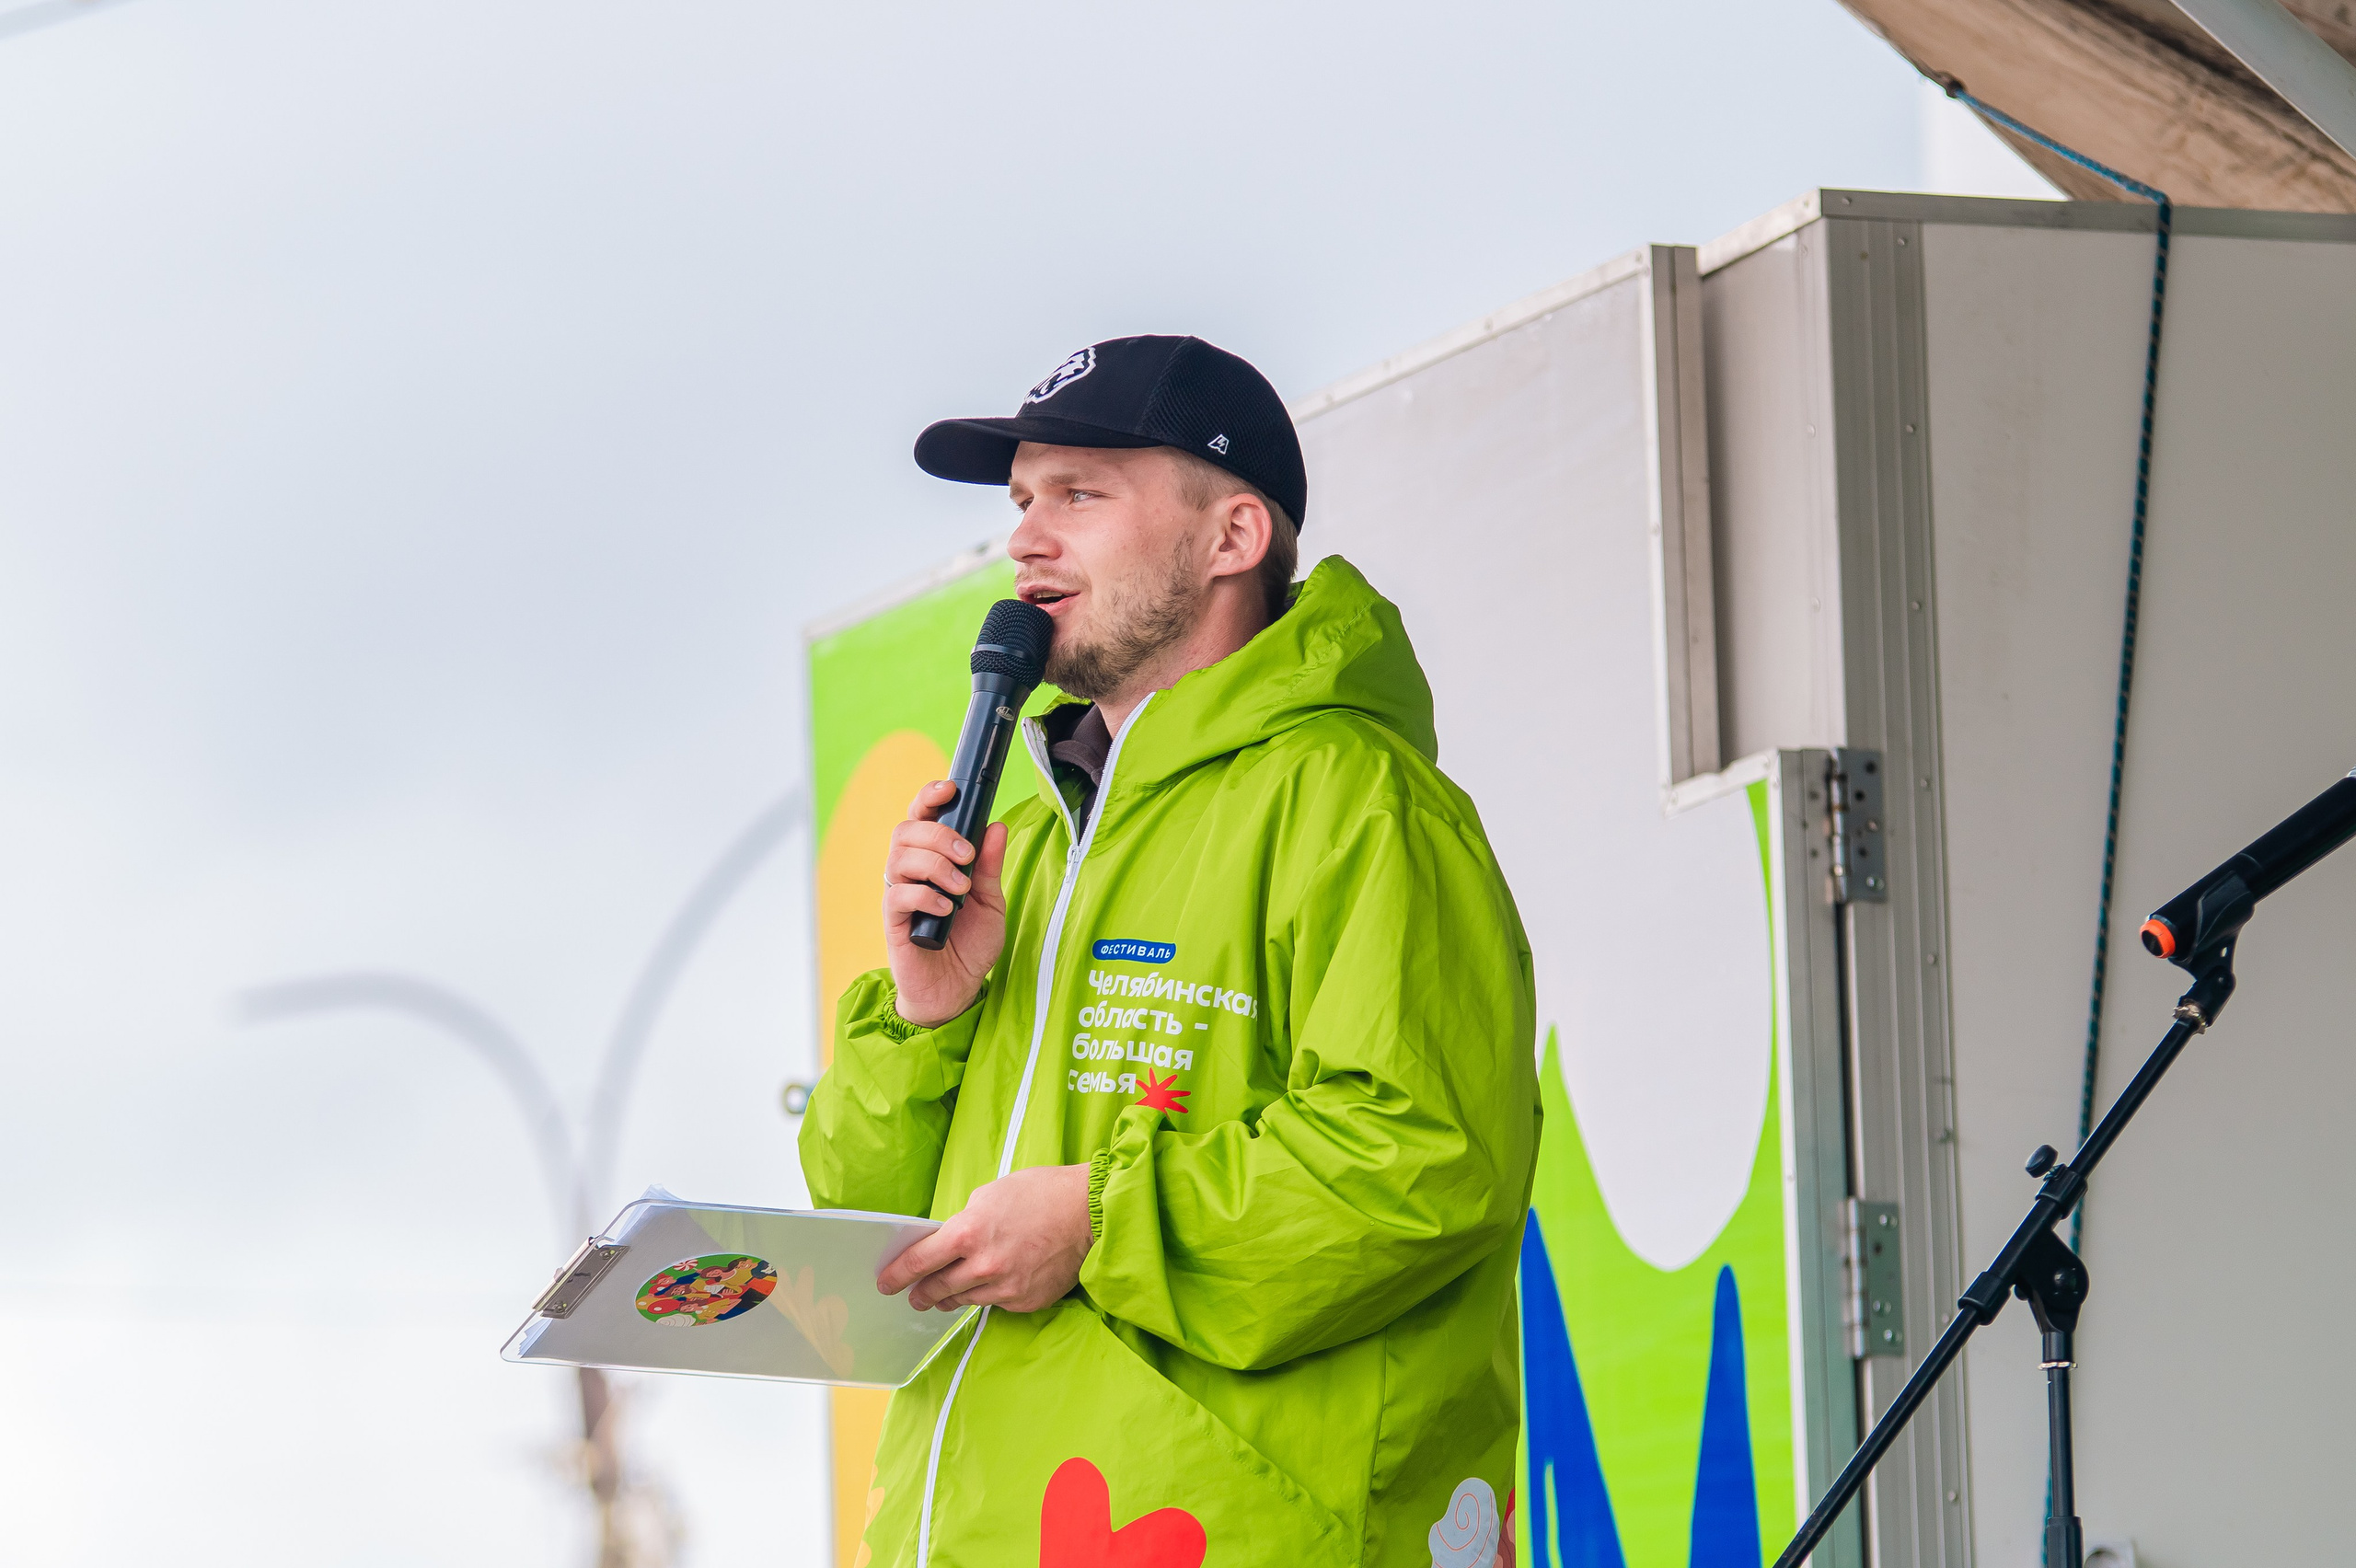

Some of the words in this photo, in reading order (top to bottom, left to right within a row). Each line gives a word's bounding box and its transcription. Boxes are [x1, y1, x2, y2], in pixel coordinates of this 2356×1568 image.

[1101, 944, 1171, 959] ФЕСТИВАЛЬ
[1078, 1000, 1183, 1035] область
[1068, 1069, 1137, 1094] семья
